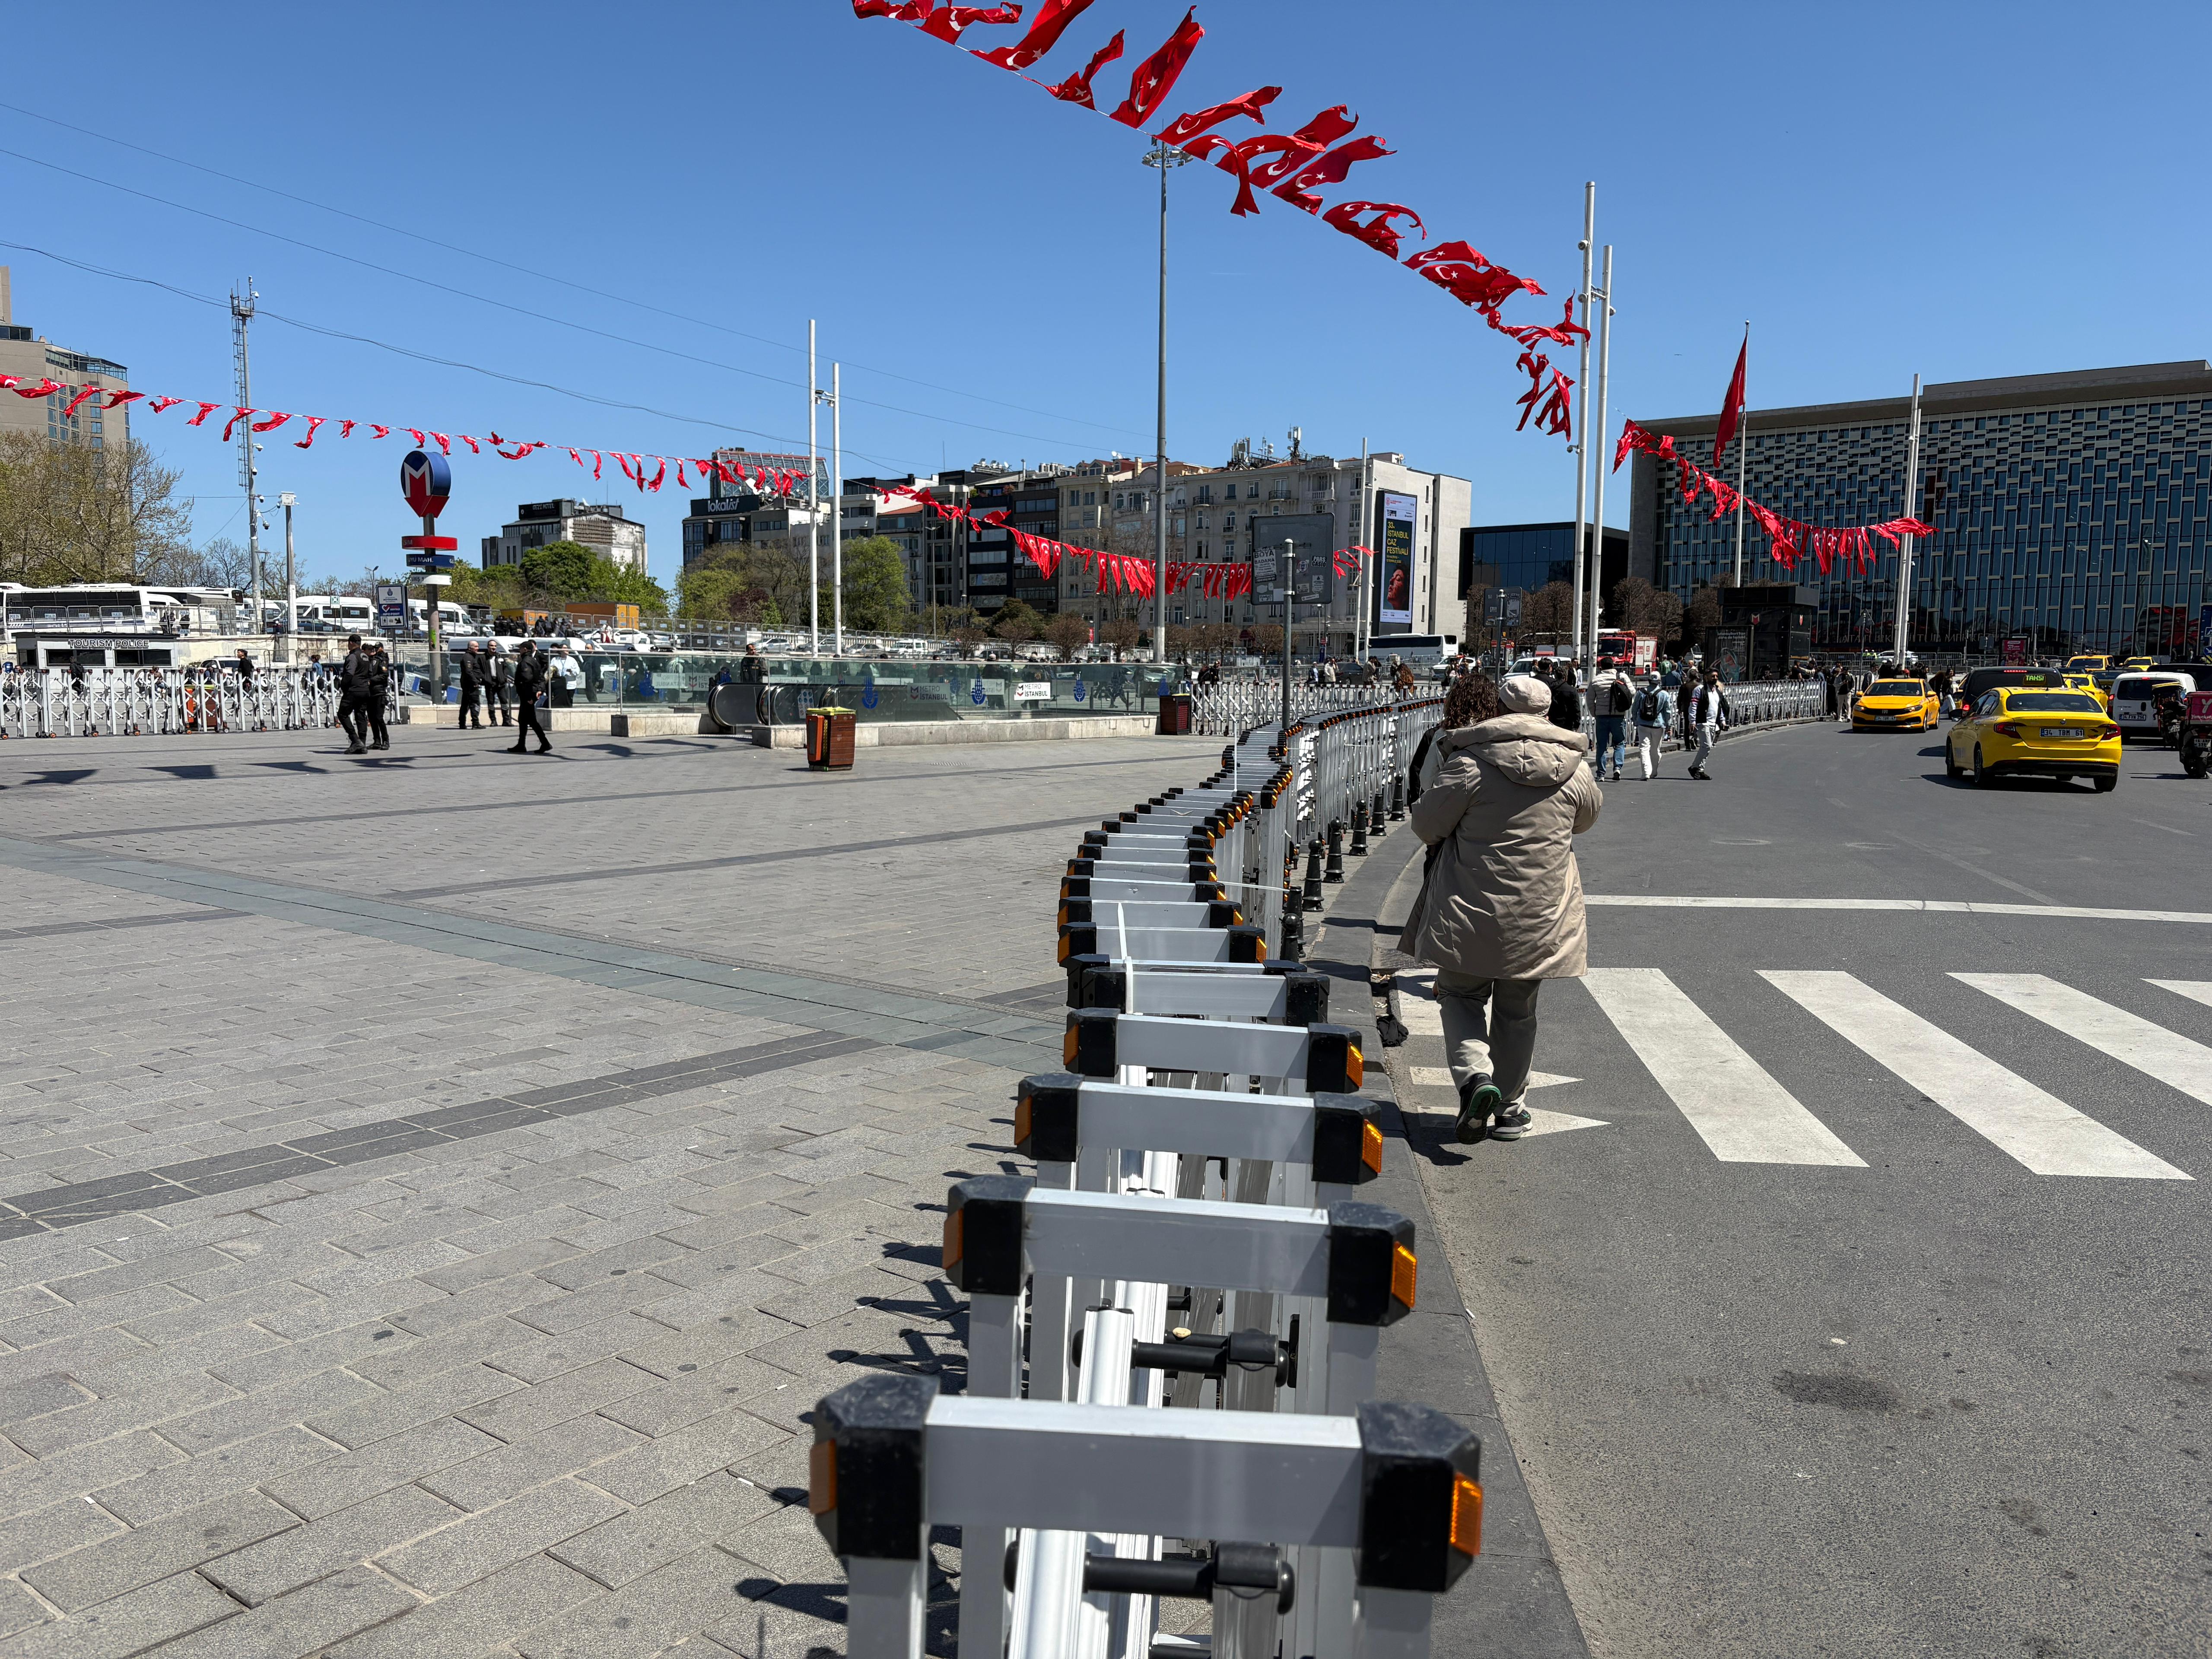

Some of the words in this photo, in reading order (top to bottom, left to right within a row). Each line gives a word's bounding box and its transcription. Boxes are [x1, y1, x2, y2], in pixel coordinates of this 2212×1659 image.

[708, 498, 740, 512] lokalist
[1387, 528, 1409, 539] İSTANBUL
[1254, 550, 1274, 558] BOYA
[1387, 546, 1408, 555] FESTİVALİ
[69, 639, 112, 647] TOURISM
[114, 639, 149, 648] POLICE
